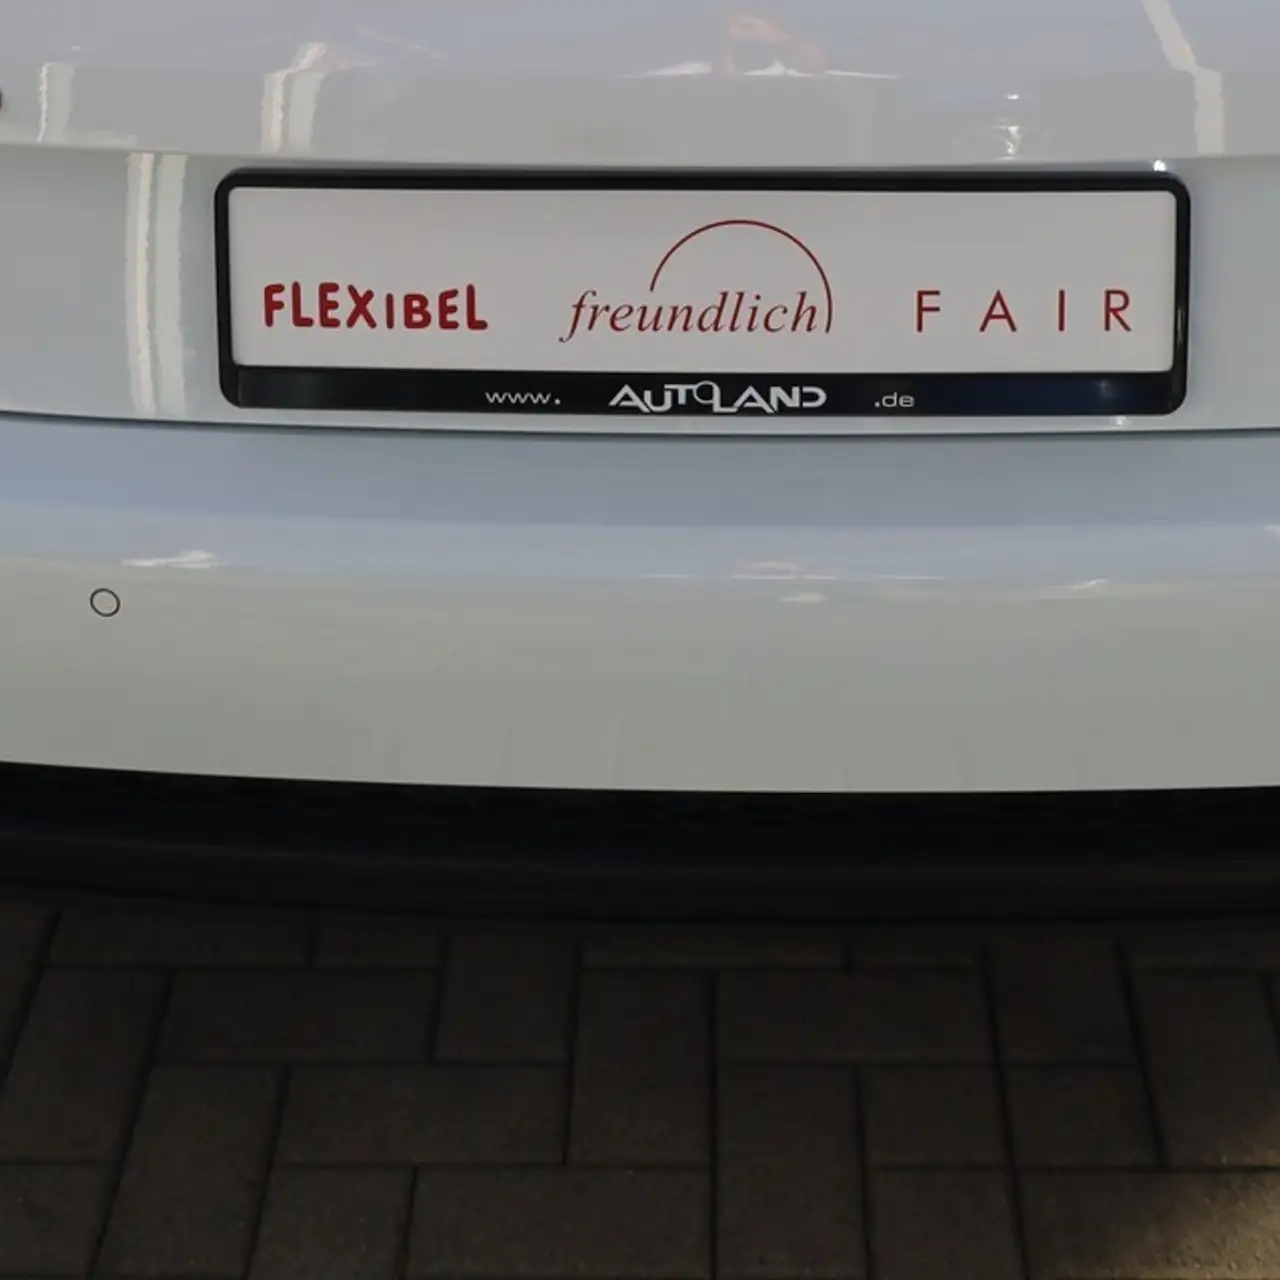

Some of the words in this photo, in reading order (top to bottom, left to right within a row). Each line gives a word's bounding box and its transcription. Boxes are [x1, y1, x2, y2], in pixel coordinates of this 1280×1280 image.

[263, 281, 489, 331] FLEXIBEL
[558, 290, 818, 343] freundlich
[915, 289, 1133, 334] FAIR
[484, 390, 562, 406] www.
[608, 380, 828, 414] AUTOLAND
[873, 391, 916, 409] .de
